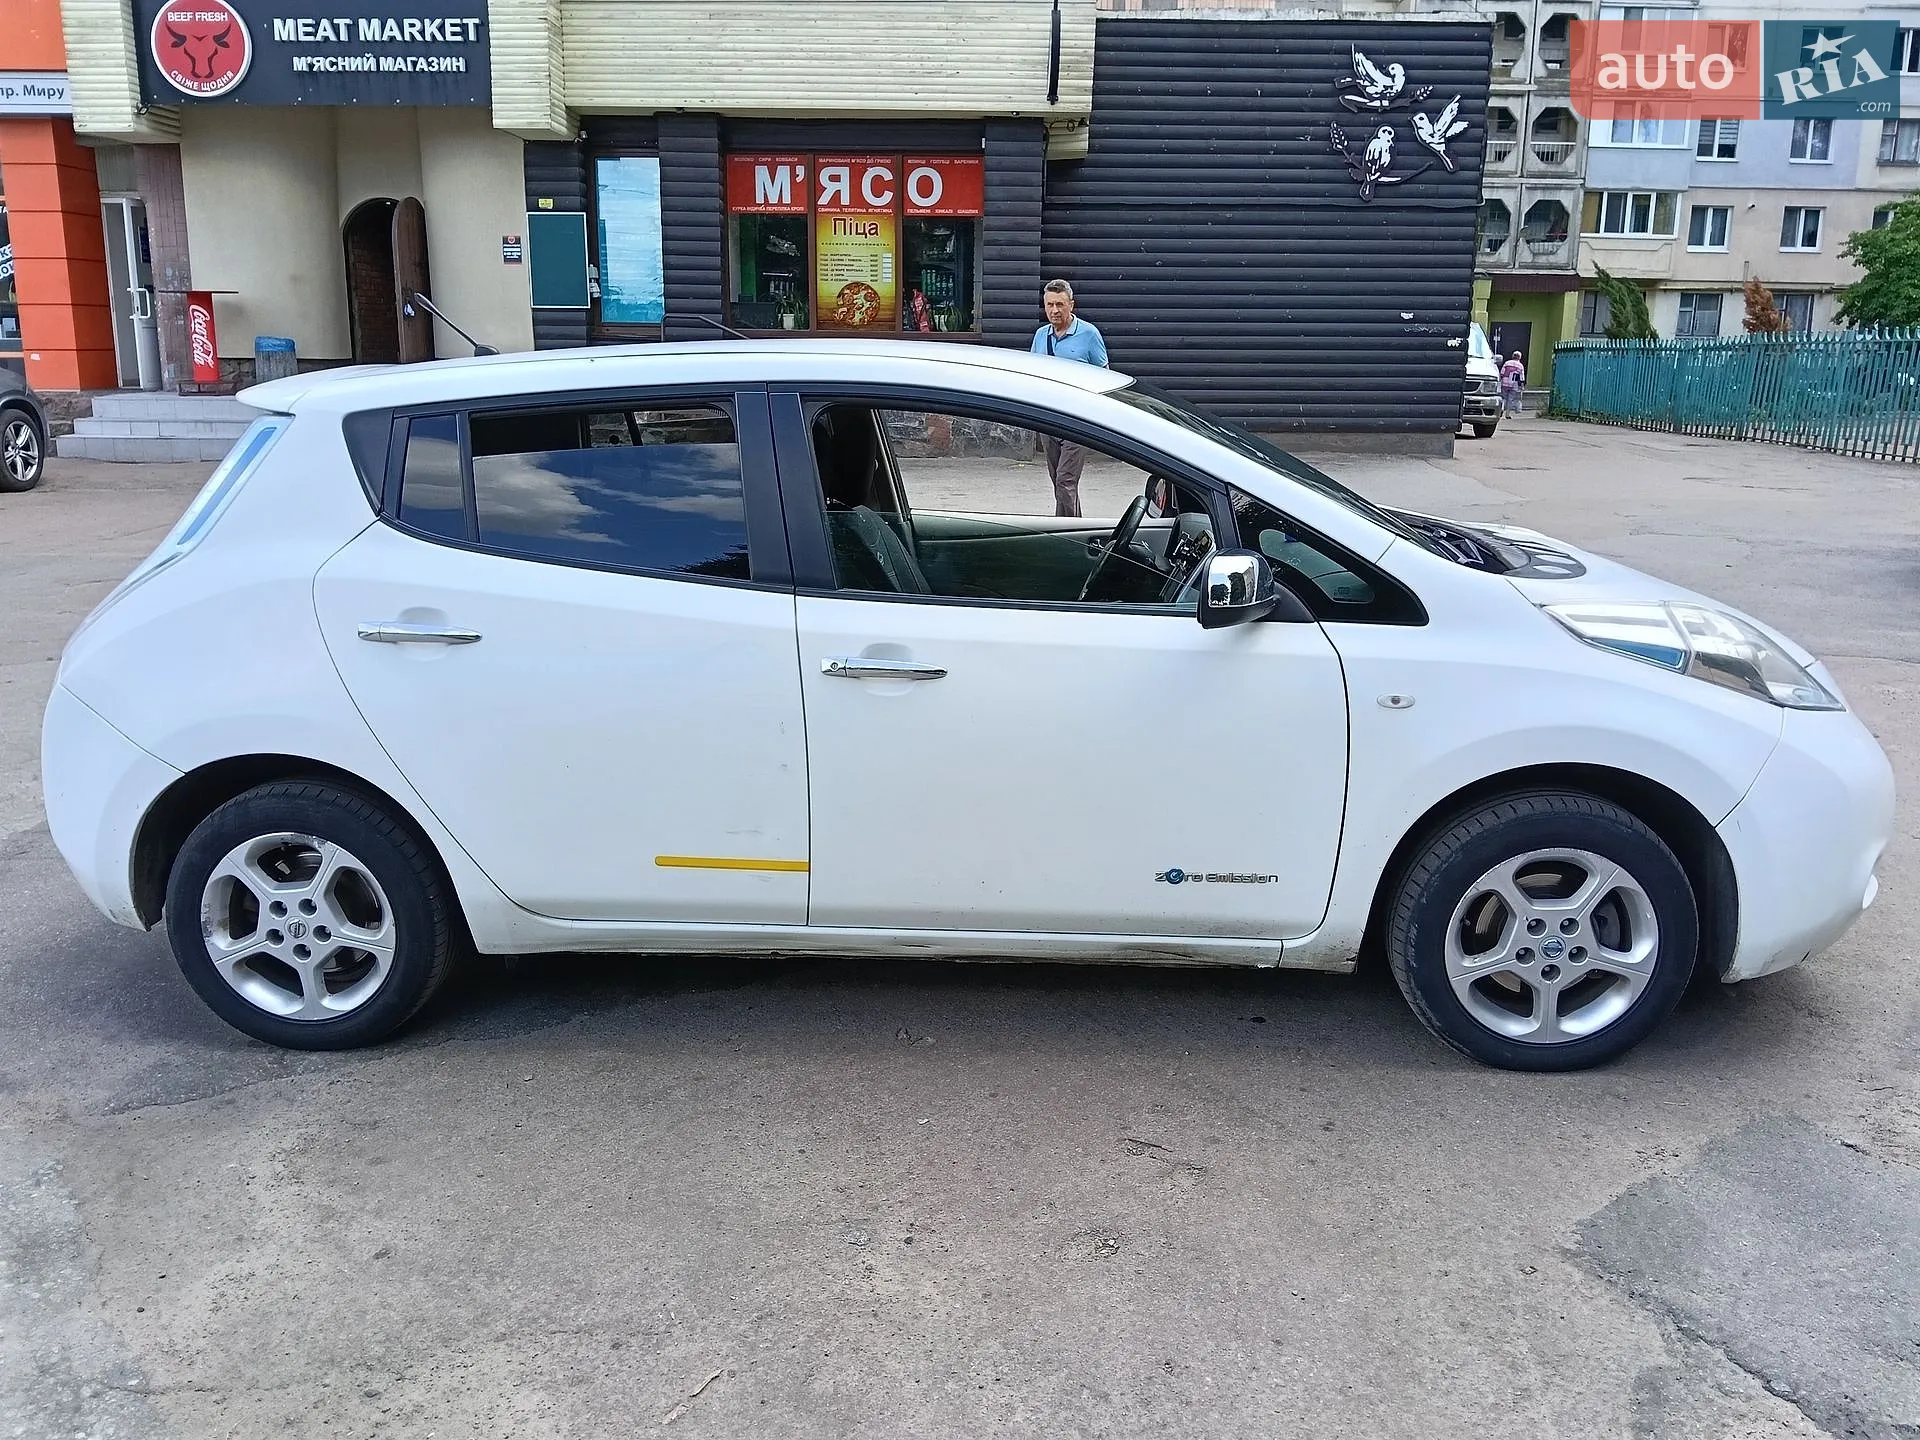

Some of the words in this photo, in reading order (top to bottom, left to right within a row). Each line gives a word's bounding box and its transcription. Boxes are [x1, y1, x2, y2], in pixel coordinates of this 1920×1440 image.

[167, 12, 193, 21] BEEF
[195, 12, 228, 21] FRESH
[273, 18, 353, 41] MEAT
[358, 18, 480, 42] MARKET
[293, 53, 376, 72] М'ЯСНИЙ
[379, 57, 466, 72] МАГАЗИН
[23, 84, 65, 100] Миру
[171, 70, 199, 90] СВІЖЕ
[201, 70, 234, 92] ЩОДНЯ
[755, 165, 943, 208] М'ЯСО
[832, 217, 879, 239] Піца
